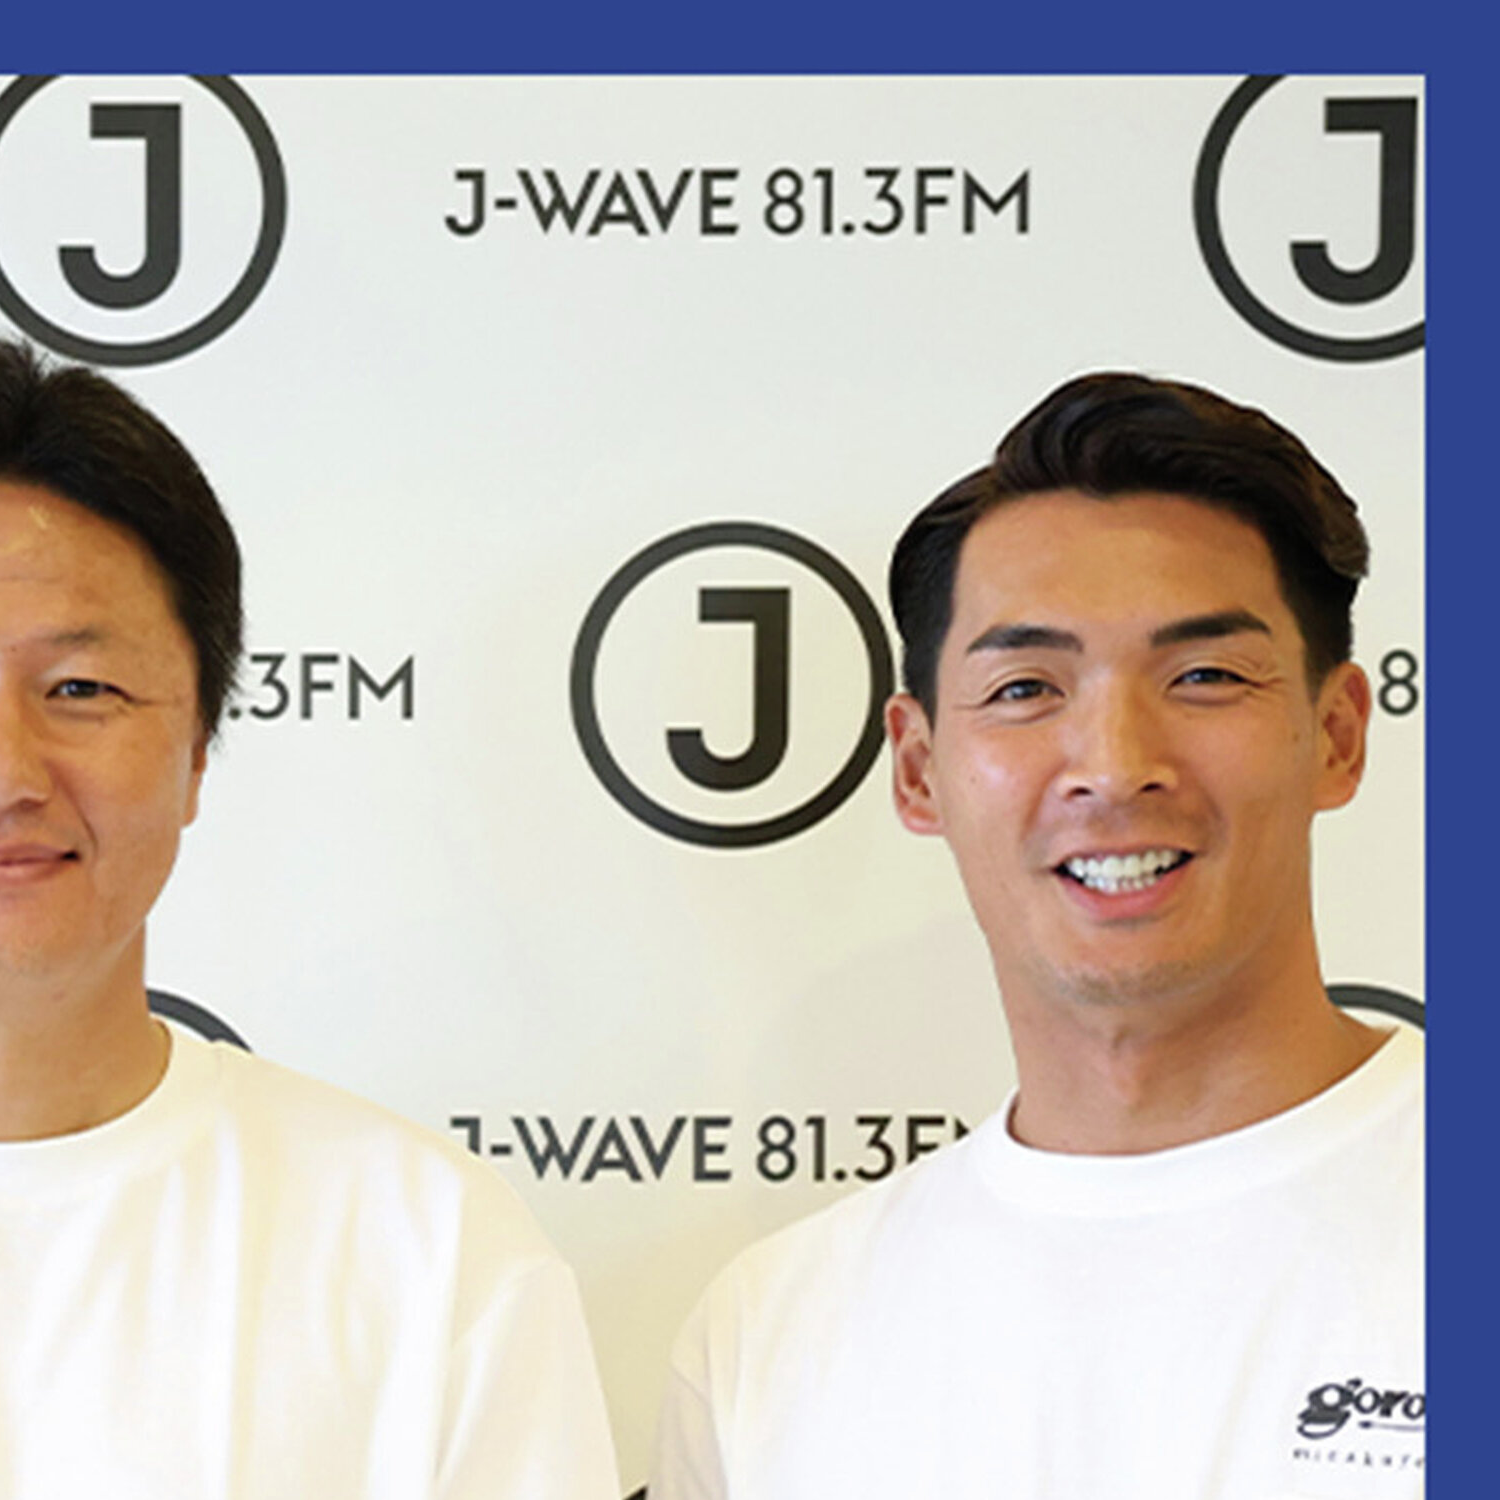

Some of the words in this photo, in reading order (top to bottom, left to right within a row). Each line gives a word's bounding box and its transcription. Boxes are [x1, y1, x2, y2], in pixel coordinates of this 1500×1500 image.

[58, 103, 181, 310] J
[444, 168, 740, 237] J-WAVE
[764, 168, 1030, 236] 81.3FM
[1289, 96, 1418, 305] J
[666, 587, 792, 792] J
[756, 1114, 970, 1183] 81.3F
